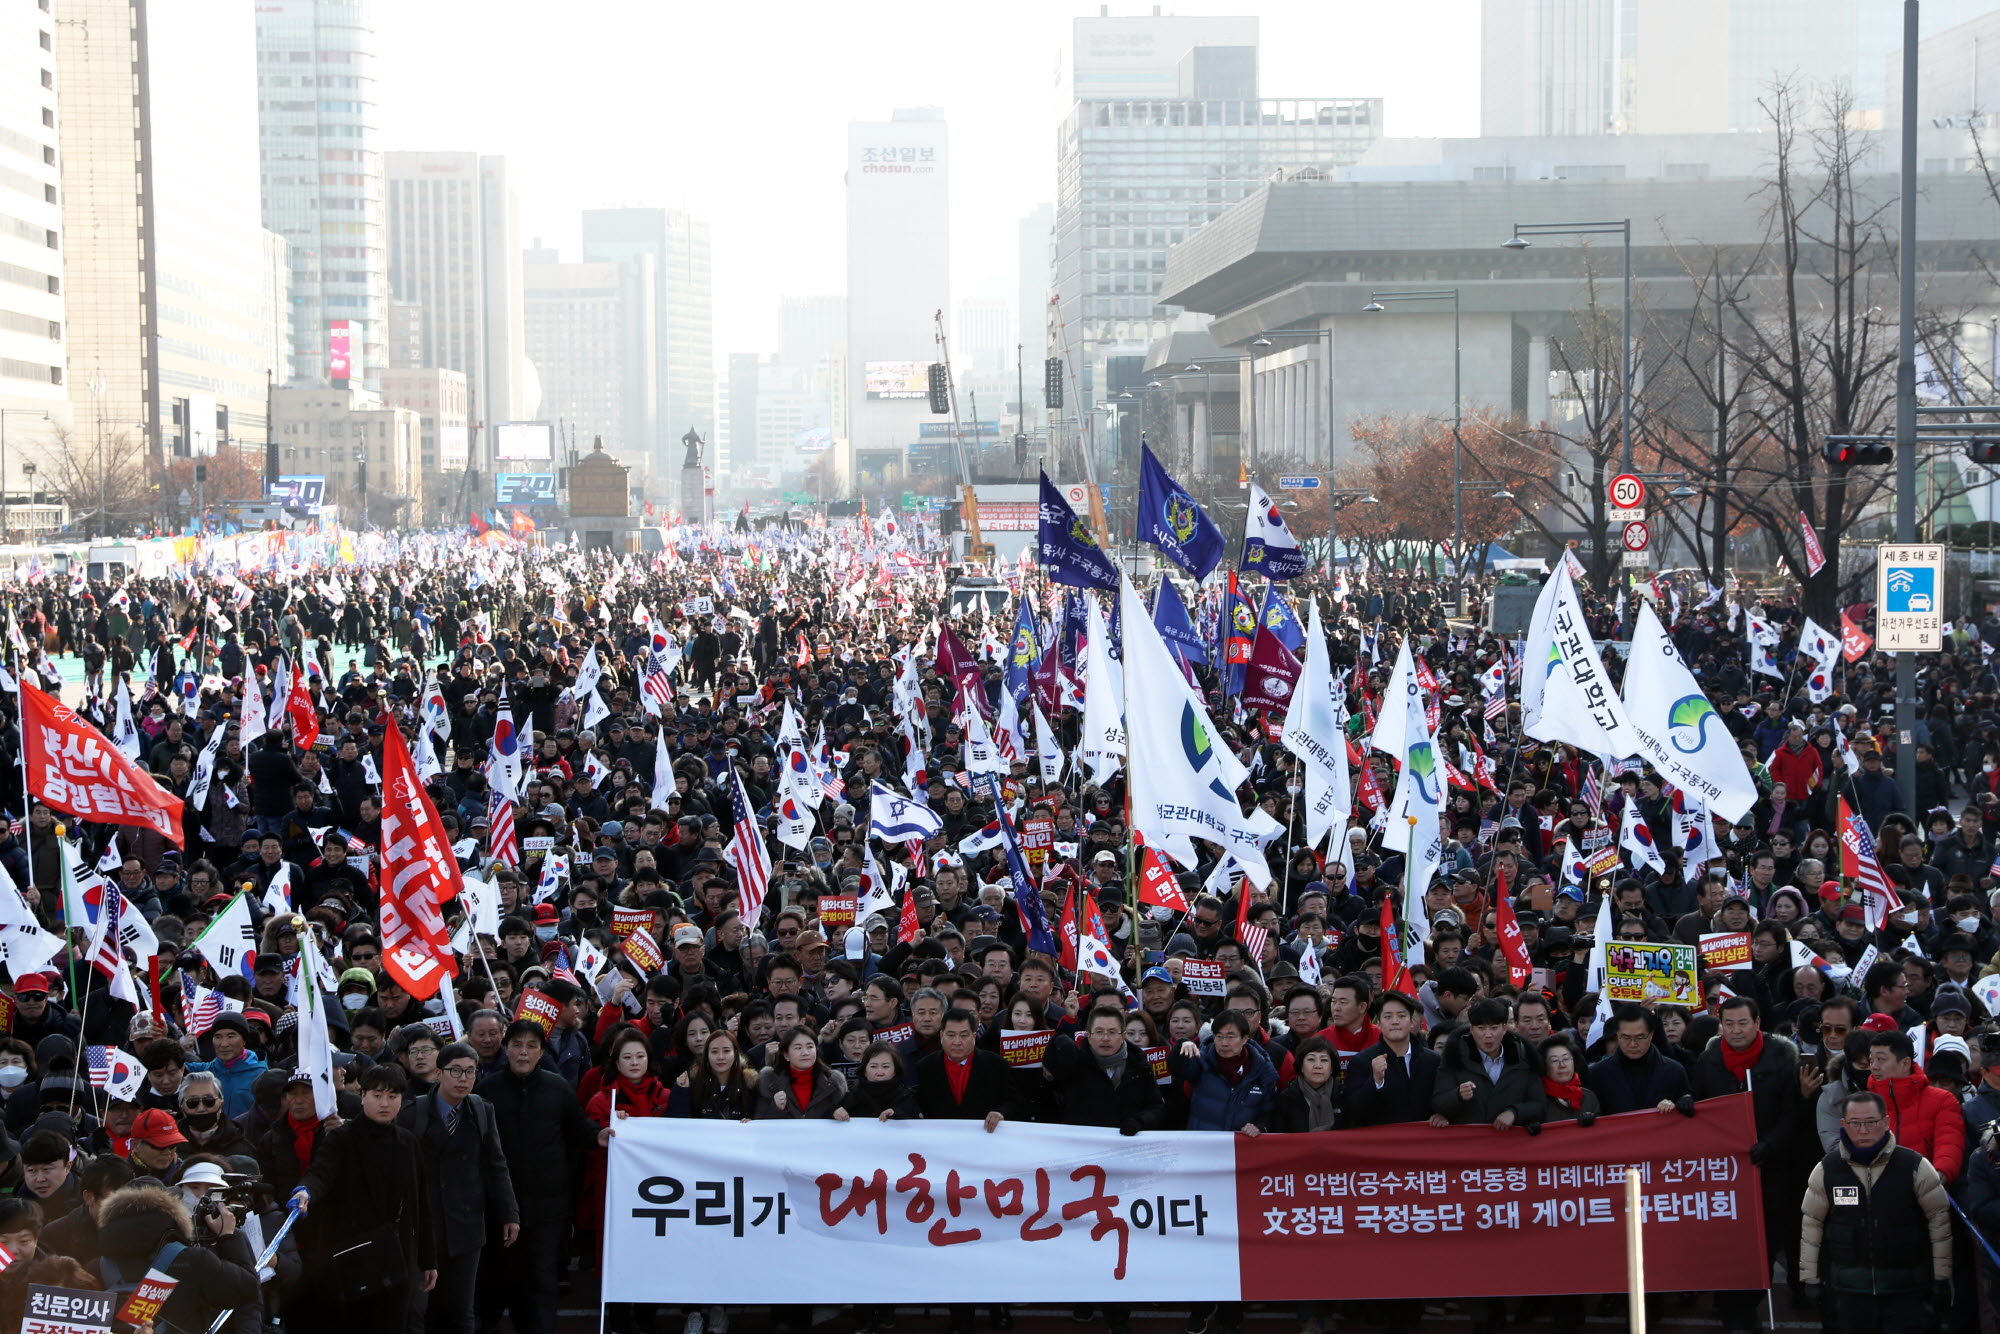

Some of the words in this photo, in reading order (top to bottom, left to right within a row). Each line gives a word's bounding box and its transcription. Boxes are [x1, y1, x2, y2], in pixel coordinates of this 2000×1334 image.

[861, 146, 936, 162] 조선일보
[863, 164, 933, 173] chosun.com
[1617, 483, 1637, 500] 50
[1884, 551, 1938, 561] 세종대로
[1882, 618, 1938, 629] 자전거우선도로
[1670, 761, 1722, 800] 구국동지회
[821, 900, 854, 910] 청와대도
[614, 913, 652, 923] 밀실야합예산
[821, 912, 854, 921] 공범이다
[1701, 935, 1747, 953] 밀실야합예산
[1184, 962, 1221, 977] 친문농단
[1609, 946, 1672, 977] 천국과지옥
[1675, 948, 1694, 970] 검색
[1608, 977, 1642, 988] 인터넷
[525, 994, 559, 1020] 청와대도
[1002, 1036, 1050, 1049] 밀실야합예산
[1260, 1174, 1295, 1197] 2대
[1660, 1156, 1738, 1183] 선거법)
[631, 1176, 790, 1237] 우리가
[815, 1152, 1208, 1280] 대한민국이다
[1263, 1205, 1344, 1236] 文정권
[1354, 1203, 1465, 1233] 국정농단
[1476, 1200, 1520, 1230] 3대
[1532, 1196, 1615, 1228] 게이트
[30, 1292, 109, 1322] 친문인사
